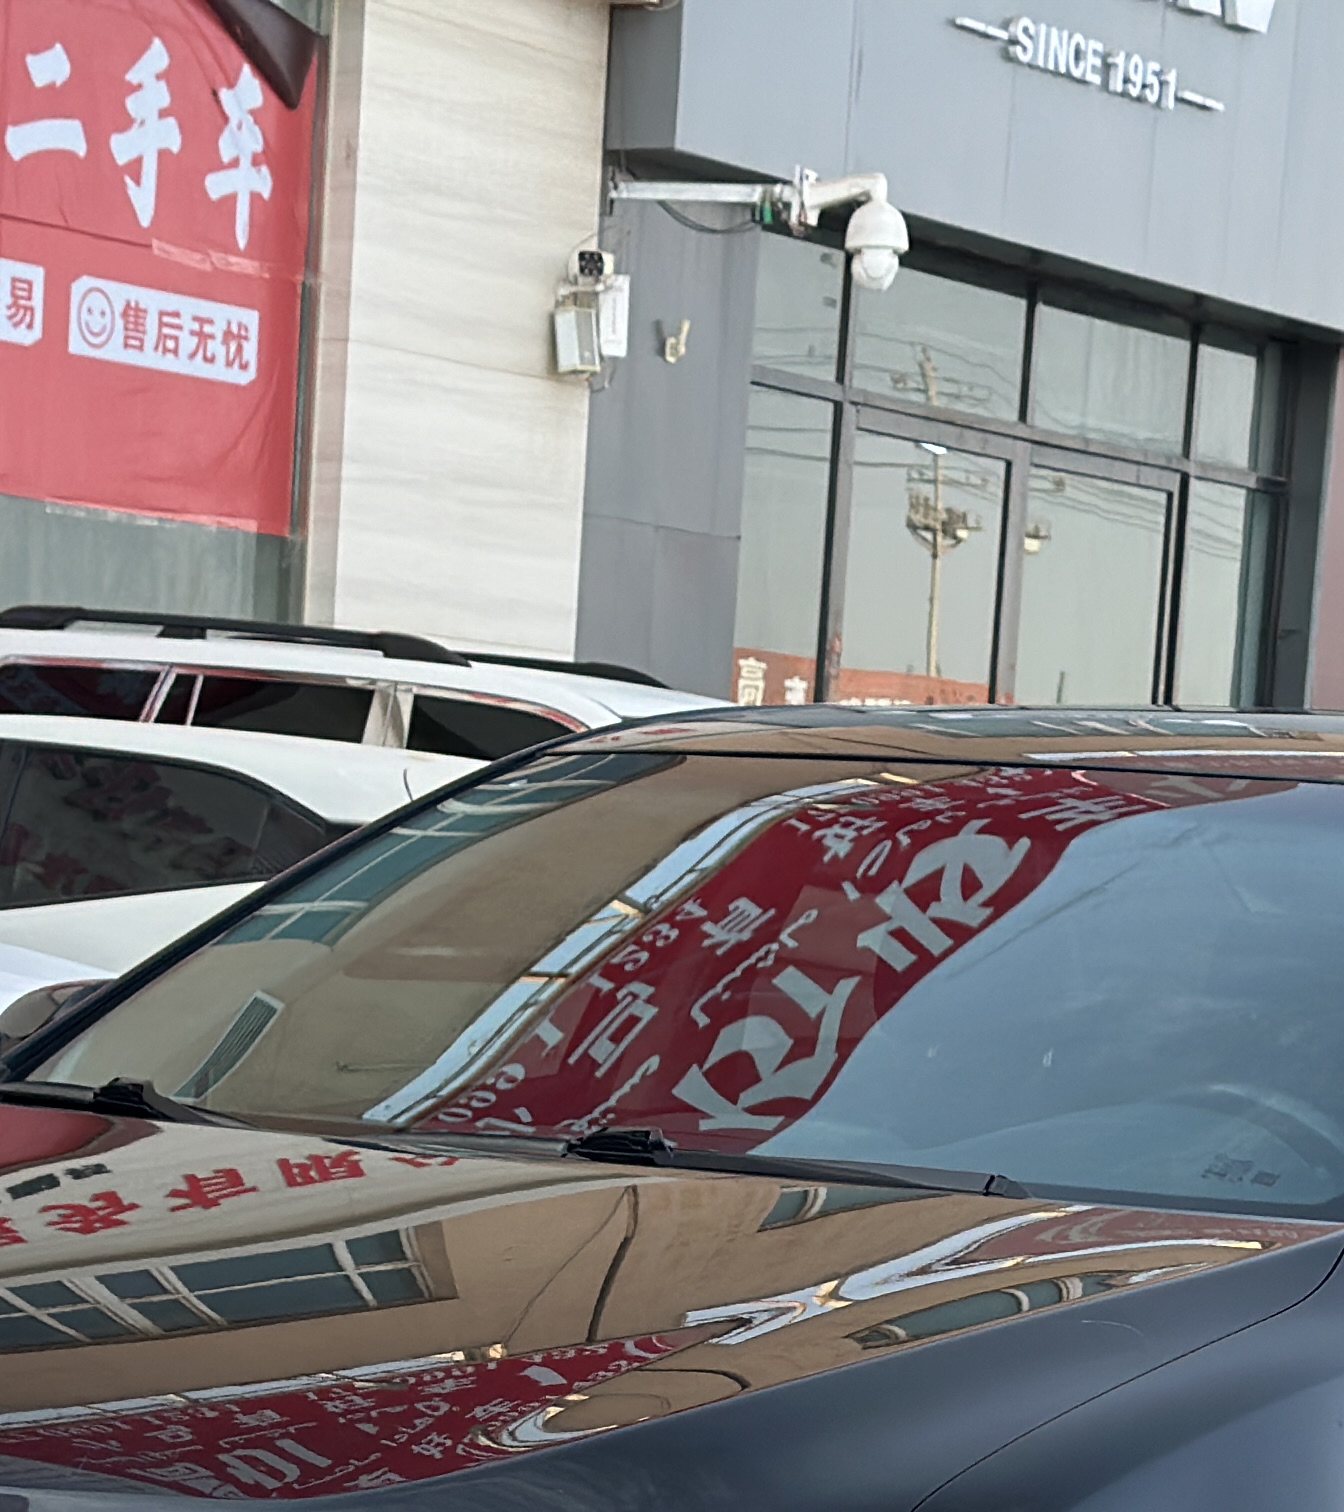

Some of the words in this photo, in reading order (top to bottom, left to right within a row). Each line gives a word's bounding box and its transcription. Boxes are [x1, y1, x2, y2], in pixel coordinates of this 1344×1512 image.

[1008, 16, 1105, 86] SINCE
[1107, 48, 1178, 110] 1951
[119, 299, 252, 374] 售后无忧
